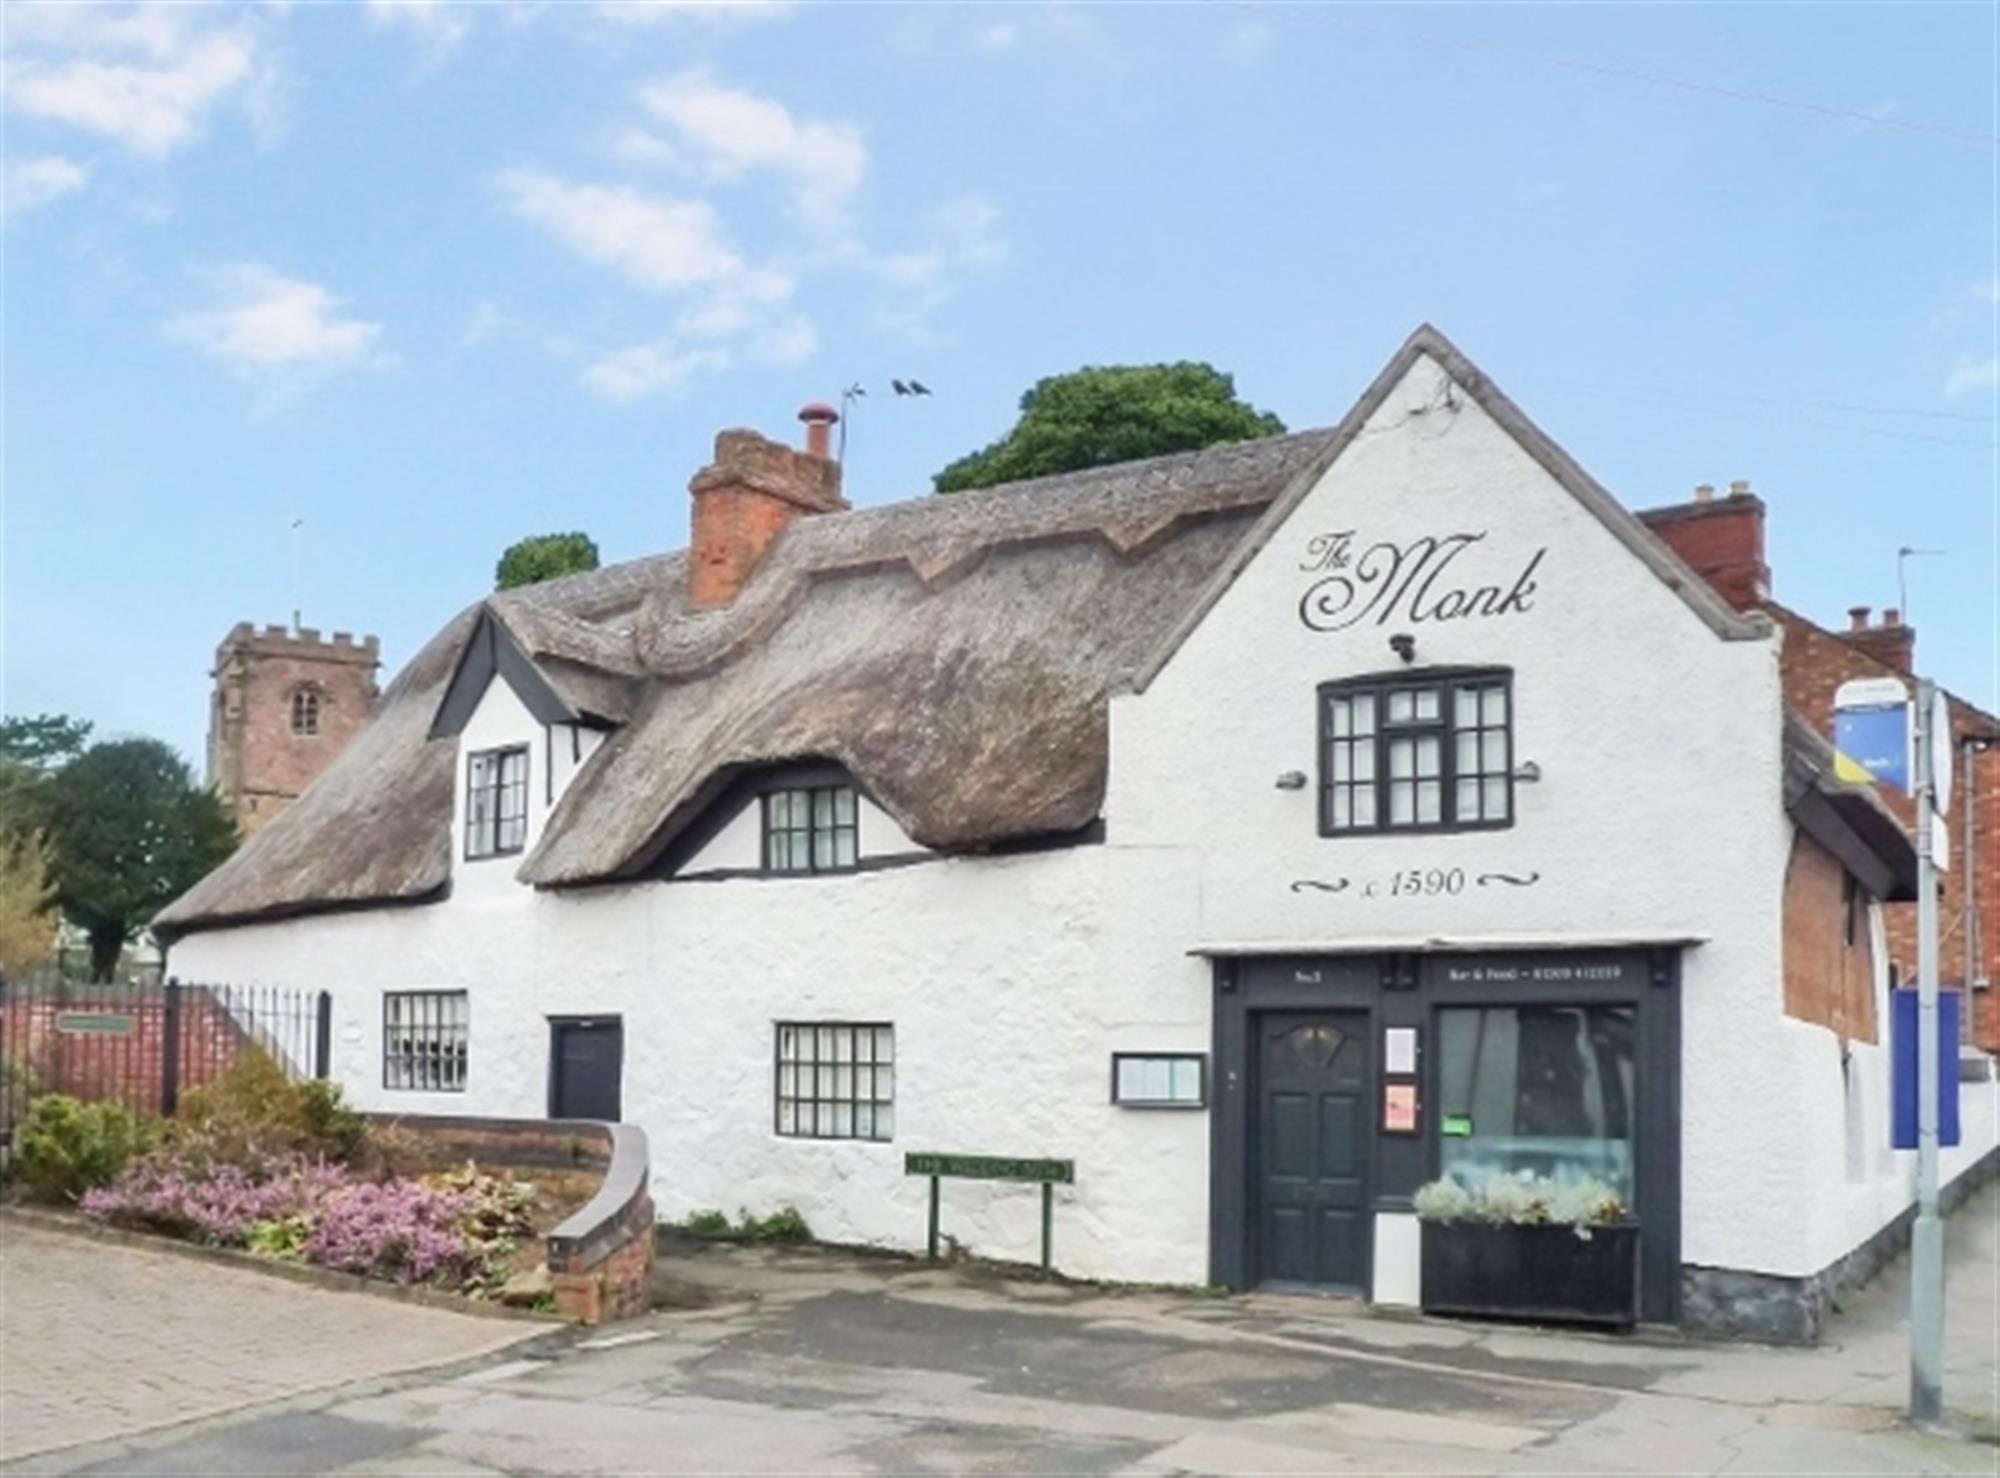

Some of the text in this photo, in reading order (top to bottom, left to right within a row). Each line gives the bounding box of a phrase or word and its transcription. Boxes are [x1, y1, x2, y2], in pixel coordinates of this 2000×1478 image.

[1300, 530, 1357, 571] The
[1299, 530, 1548, 632] Monk
[1391, 868, 1465, 897] 1590
